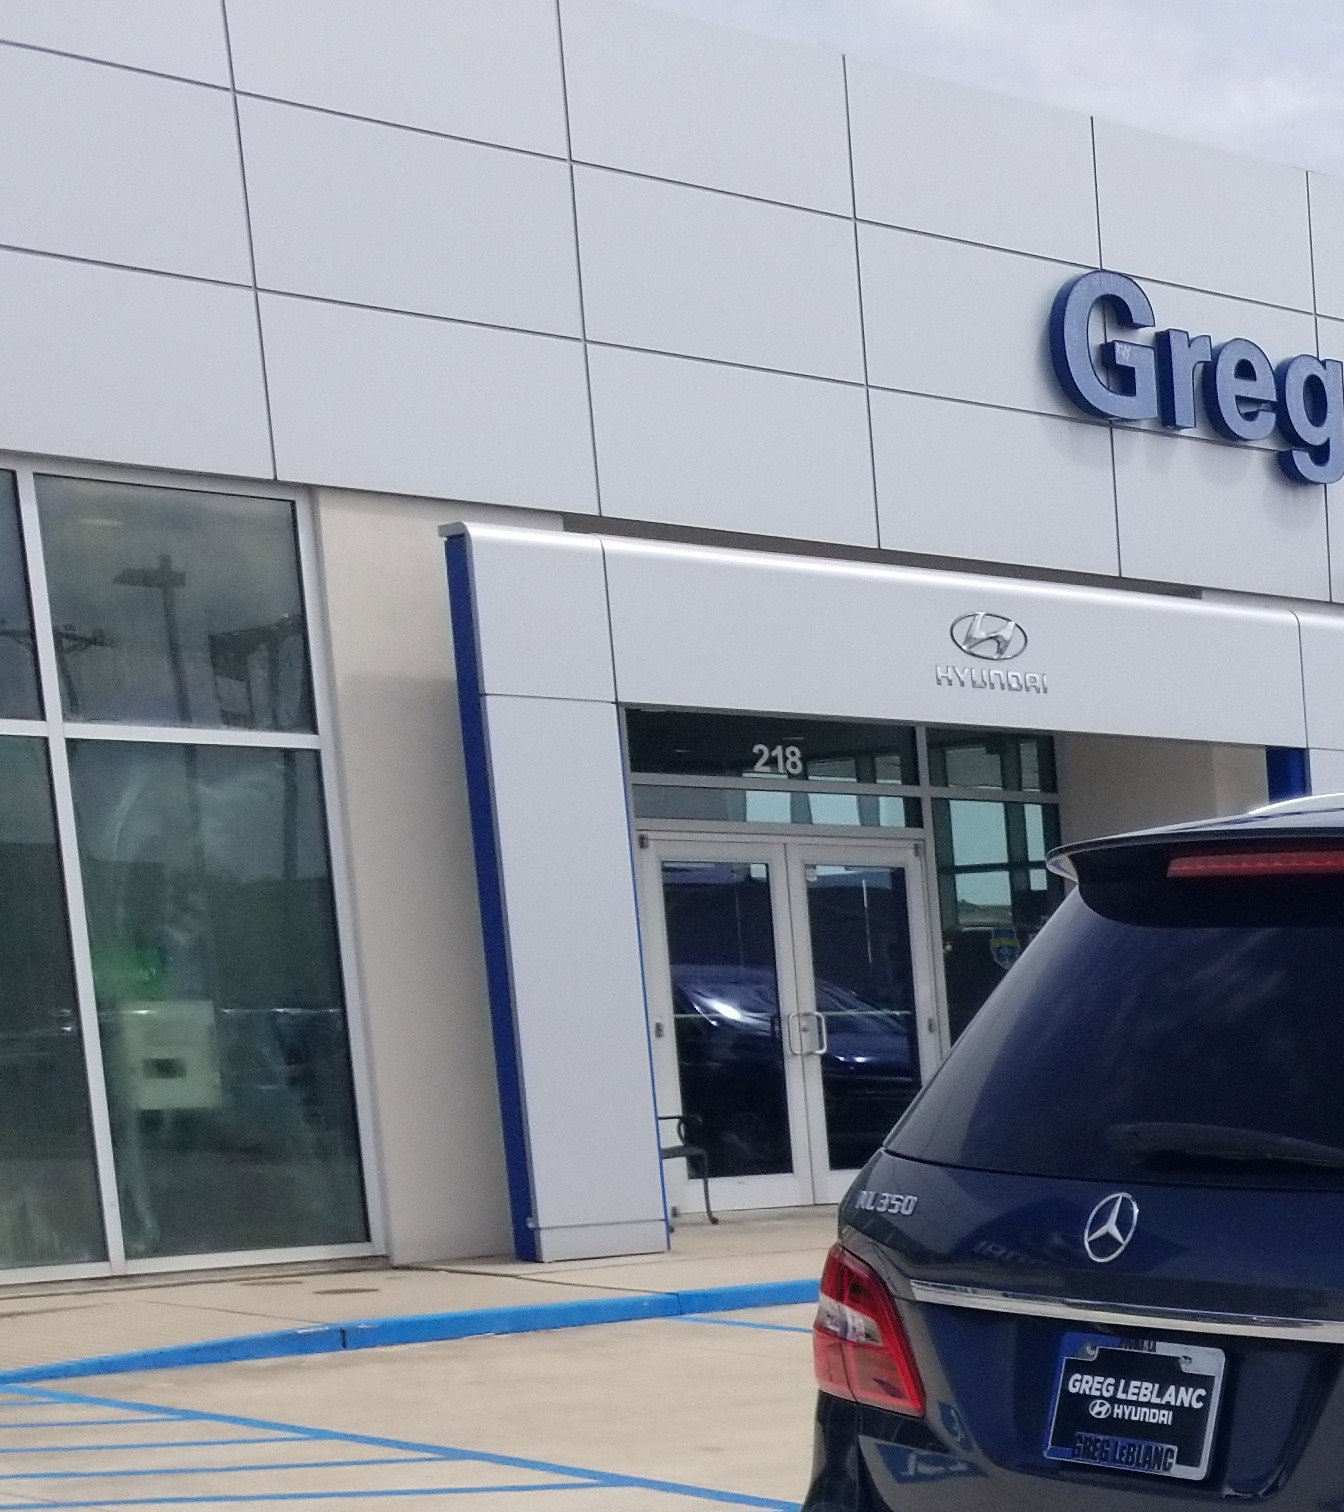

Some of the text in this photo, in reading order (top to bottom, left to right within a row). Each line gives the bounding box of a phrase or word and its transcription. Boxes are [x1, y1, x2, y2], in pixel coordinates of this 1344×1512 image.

[935, 665, 1048, 693] HYUNDAI
[752, 743, 803, 775] 218
[1068, 1373, 1207, 1409] GREG LEBLANC
[1113, 1403, 1174, 1425] HYUNDAI
[1114, 1439, 1176, 1472] LEBLANC
